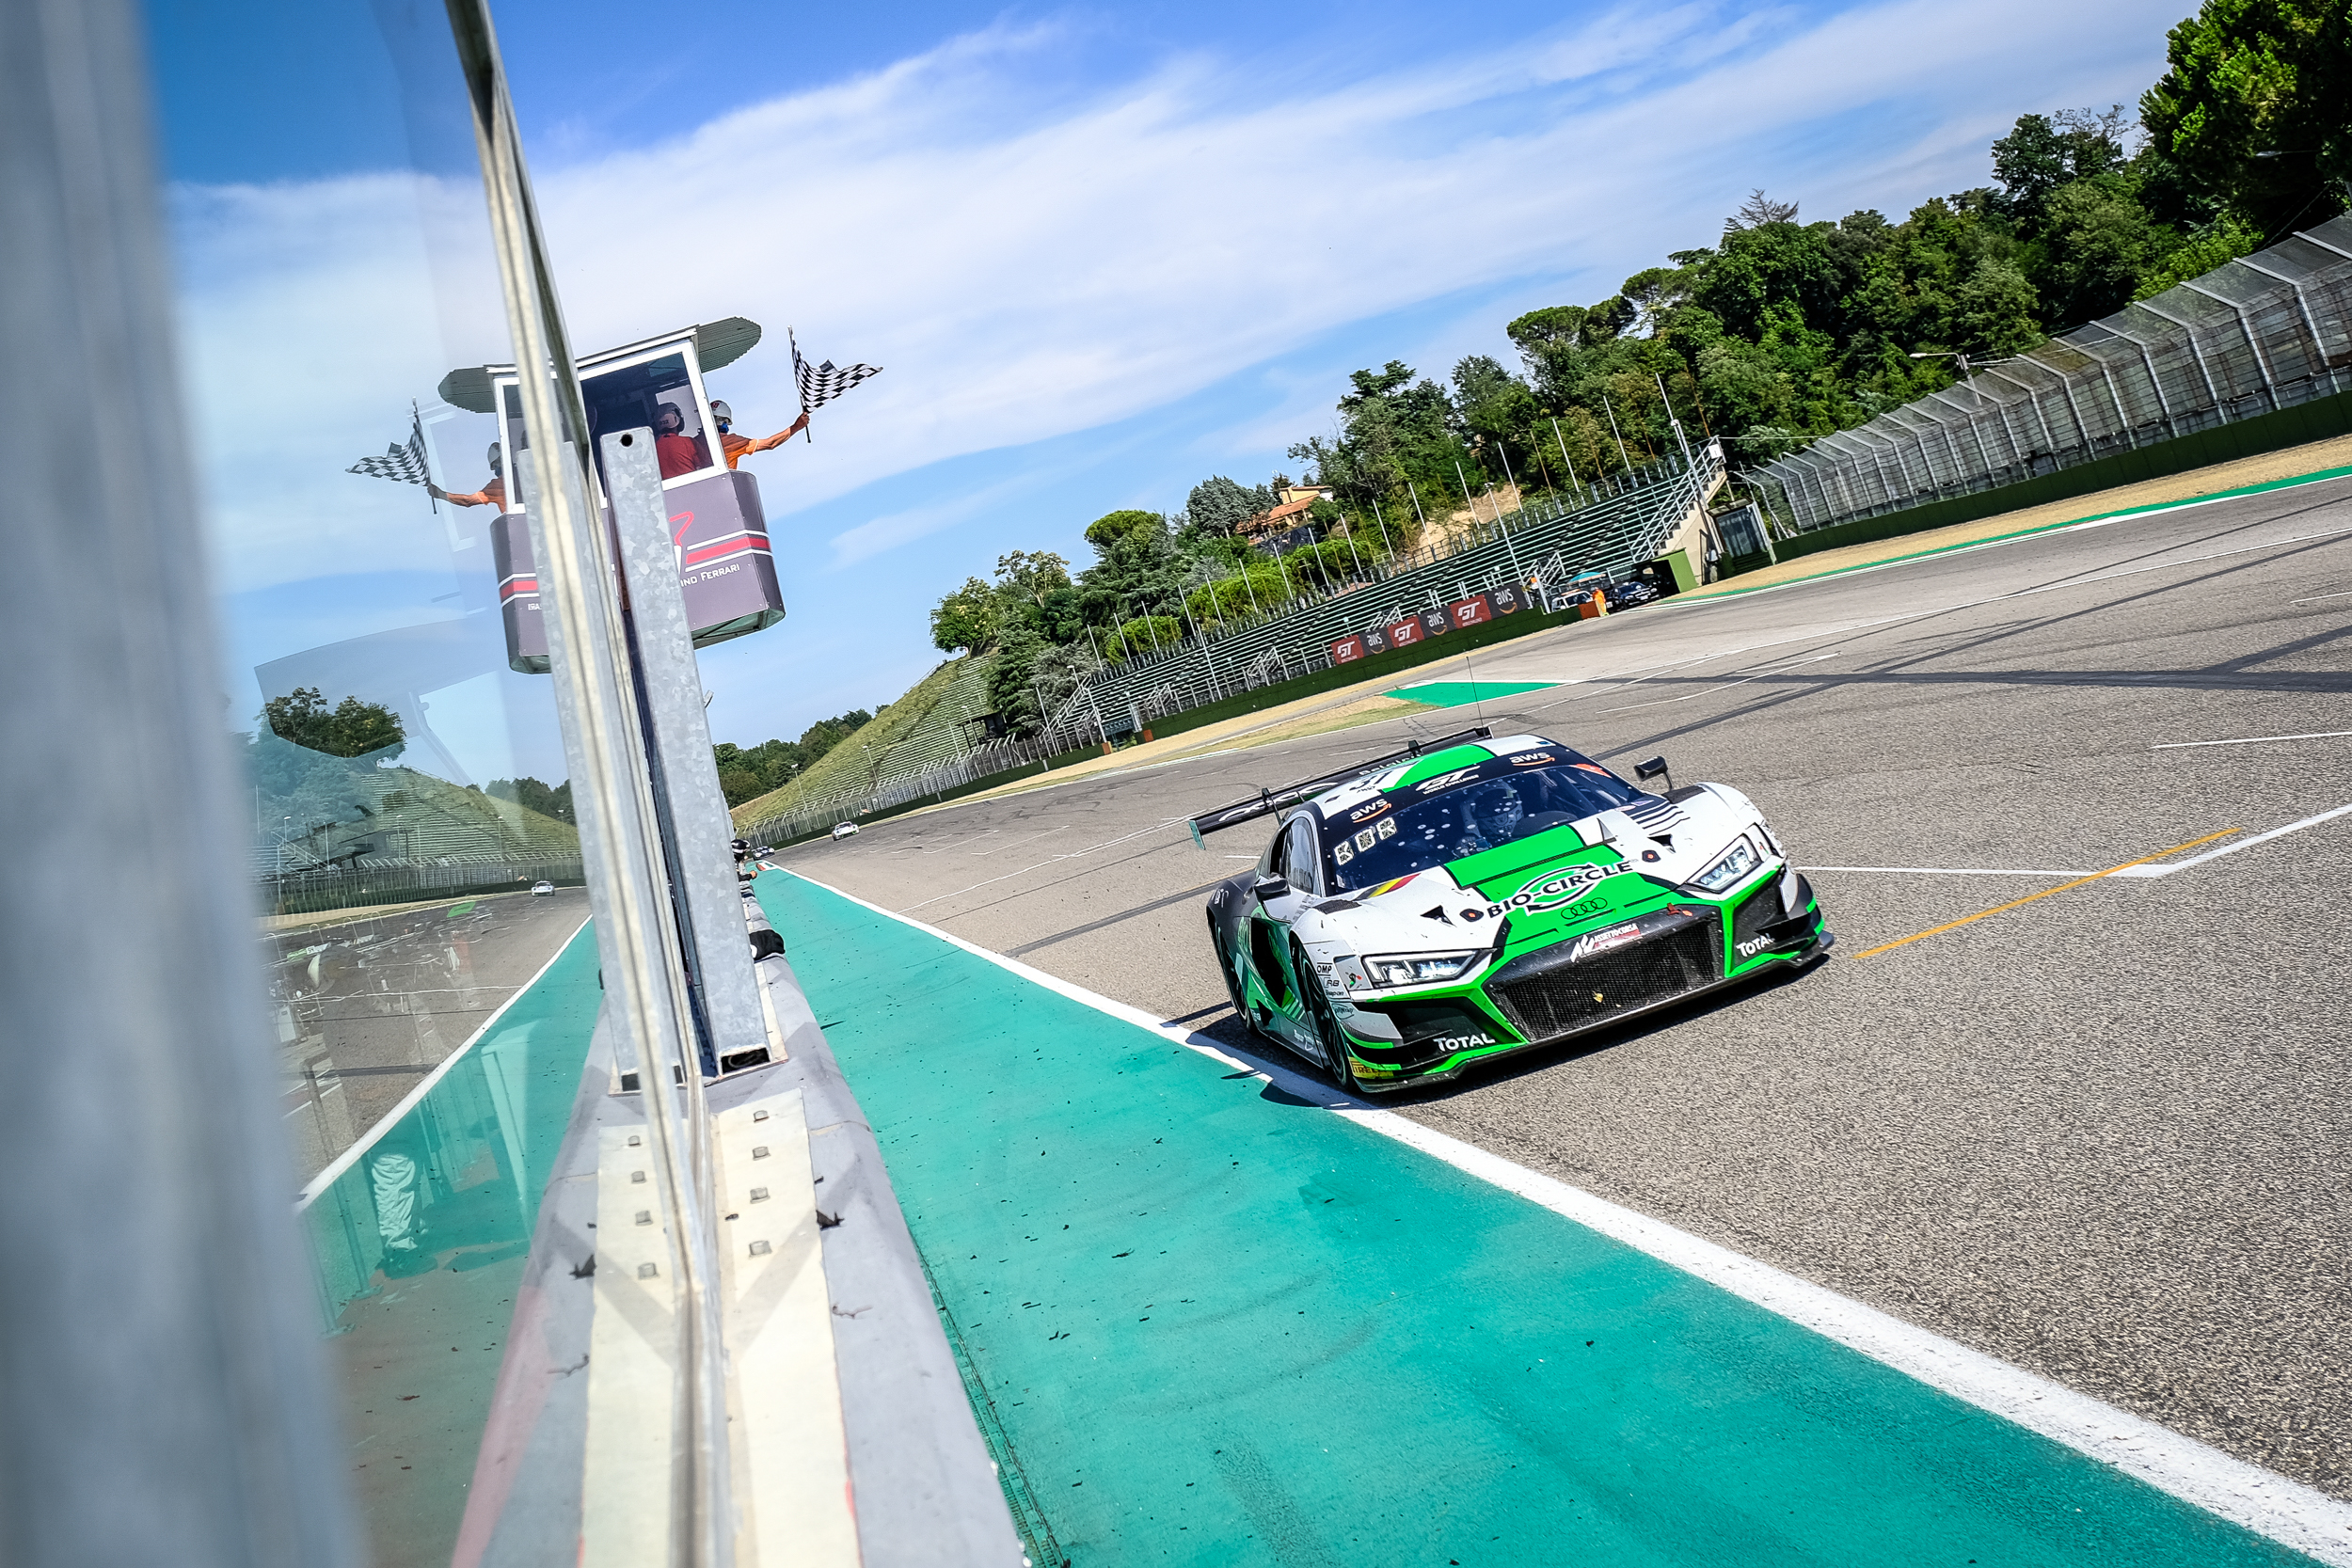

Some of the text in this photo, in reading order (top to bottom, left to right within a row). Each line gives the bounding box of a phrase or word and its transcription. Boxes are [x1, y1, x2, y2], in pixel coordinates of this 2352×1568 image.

[700, 563, 740, 581] FERRARI
[1494, 588, 1514, 605] aws
[1427, 611, 1444, 627] aws
[1457, 601, 1481, 621] GT
[1367, 632, 1383, 646] aws
[1394, 623, 1415, 641] GT
[1337, 641, 1356, 657] GT
[1509, 752, 1550, 764] aws
[1415, 766, 1481, 791] GT
[1350, 799, 1388, 820] aws
[1486, 861, 1633, 918] BIO-CIRCLE
[1736, 932, 1775, 957] TOTAL
[1317, 965, 1332, 974] OMP
[1433, 1033, 1496, 1052] TOTAL
